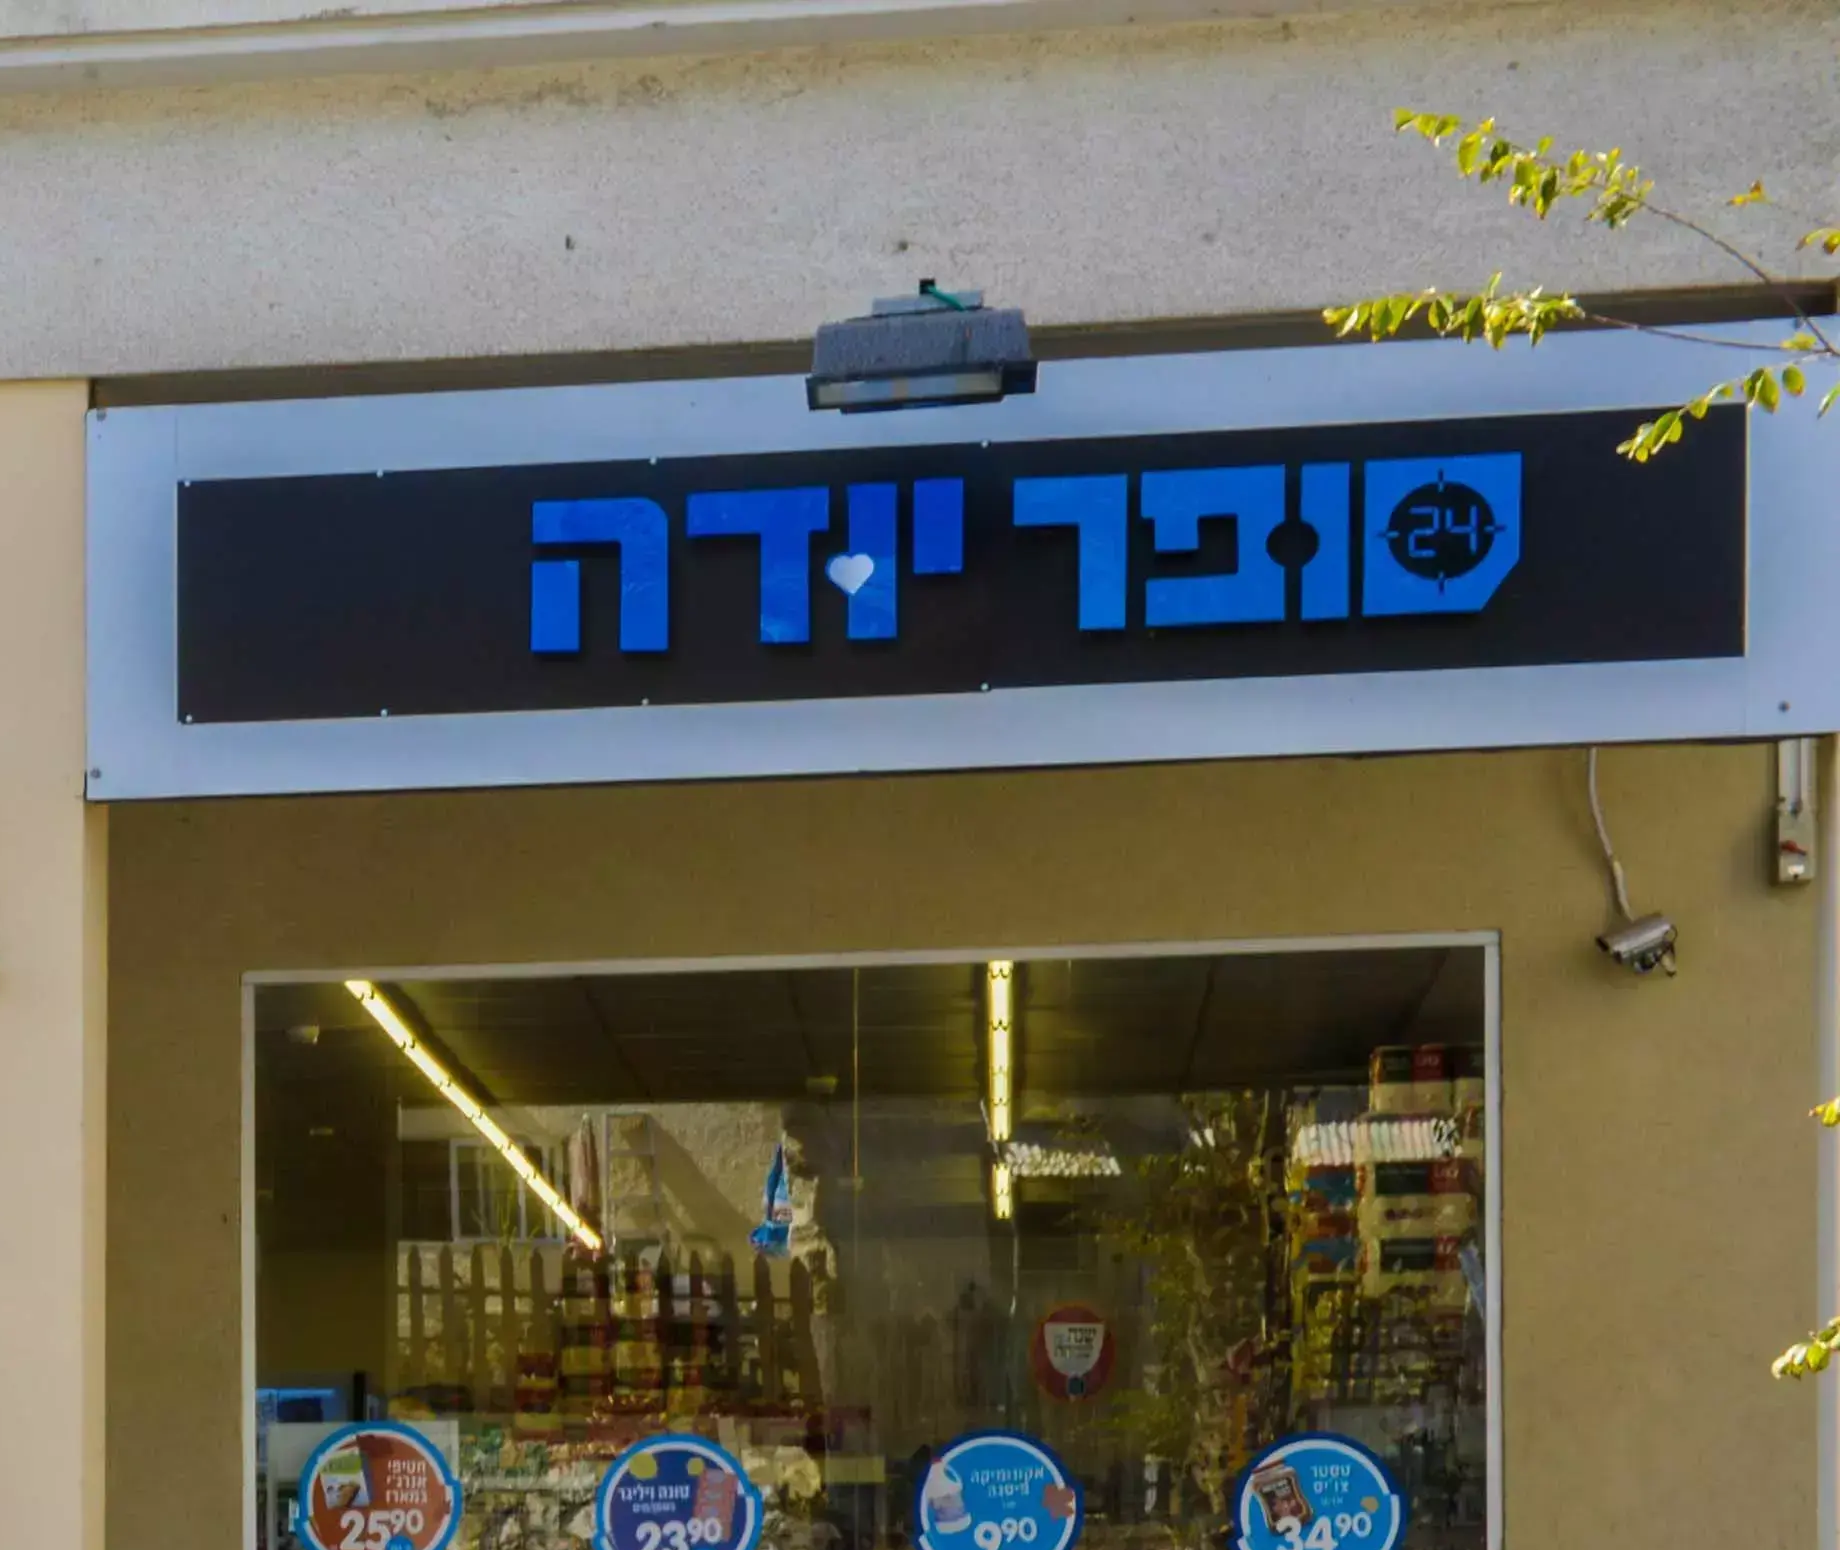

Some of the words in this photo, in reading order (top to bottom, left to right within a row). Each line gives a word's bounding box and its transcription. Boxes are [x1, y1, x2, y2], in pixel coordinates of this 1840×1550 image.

[531, 475, 964, 654] יודה
[1013, 451, 1522, 632] סופר
[1406, 504, 1479, 558] 24
[658, 1484, 691, 1500] טונה
